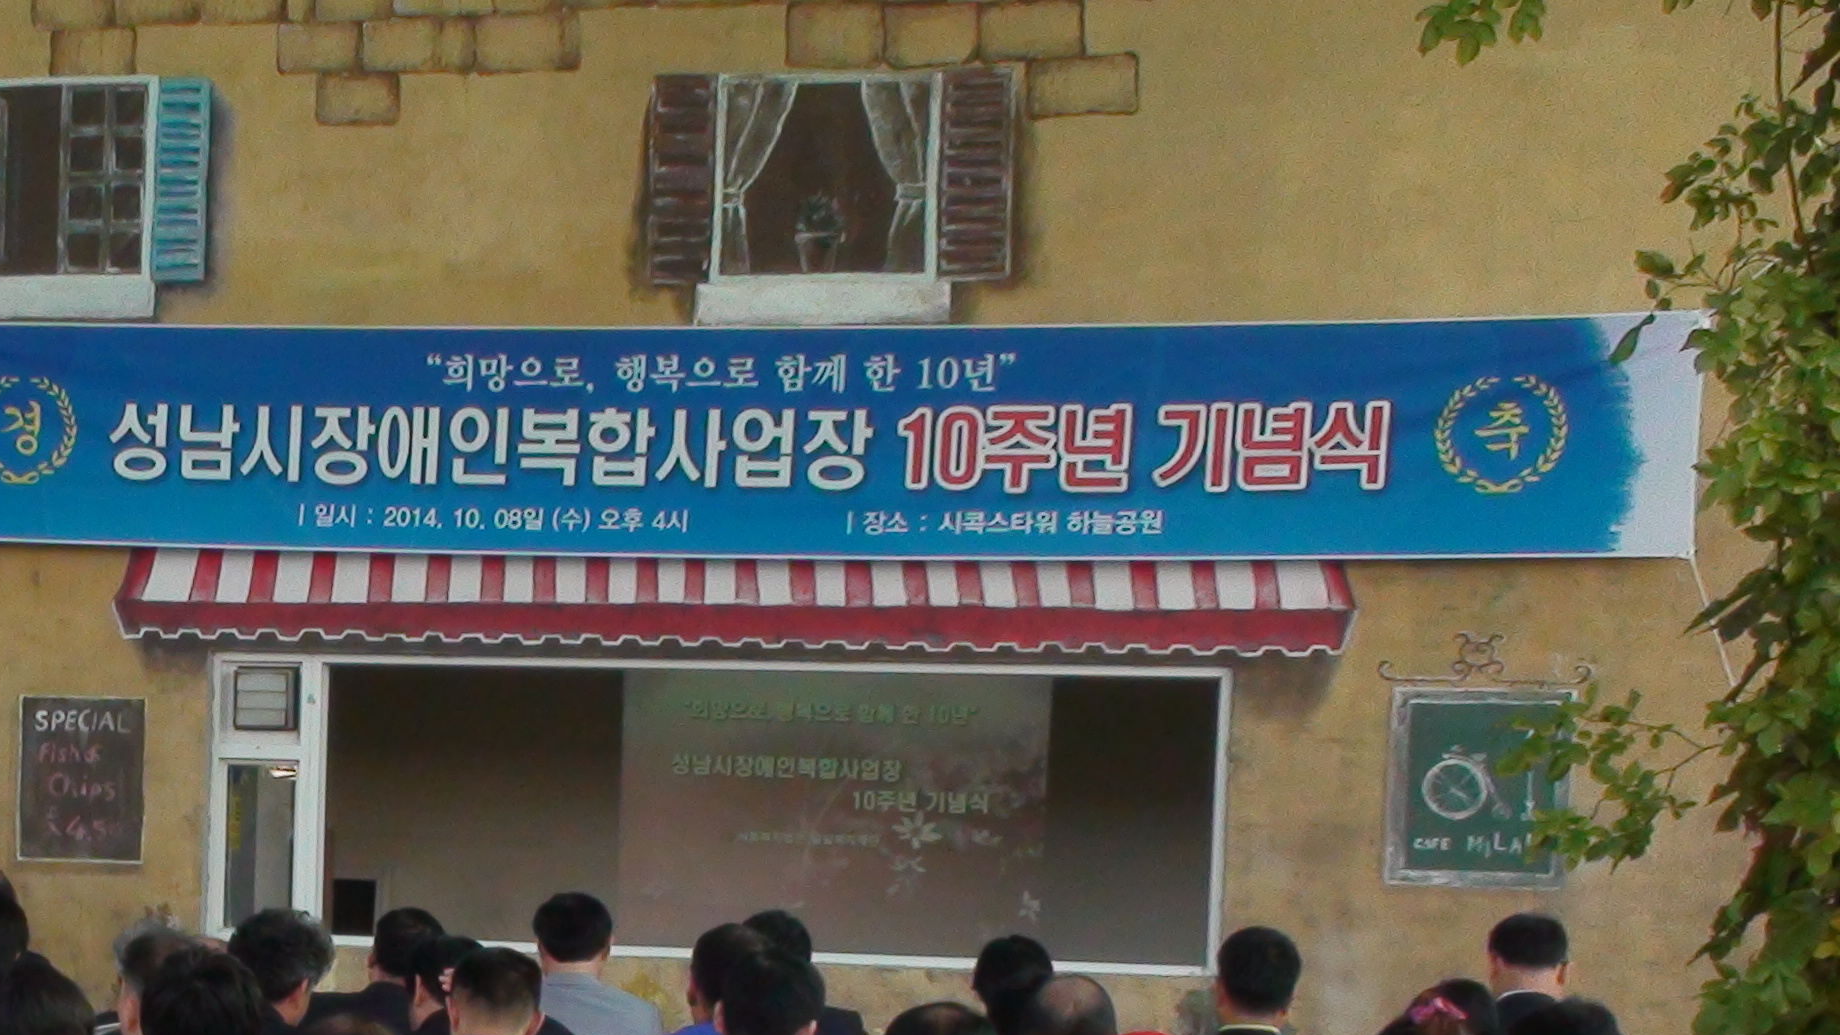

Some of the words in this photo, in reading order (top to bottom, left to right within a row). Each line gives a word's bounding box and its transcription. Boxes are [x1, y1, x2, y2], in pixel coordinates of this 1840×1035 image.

[426, 352, 594, 394] “희망으로,
[615, 353, 760, 393] 행복으로
[774, 353, 847, 394] 함께
[863, 353, 902, 393] 한
[916, 352, 1017, 393] 10년”
[0, 400, 42, 458] 경
[1474, 401, 1531, 460] 축
[108, 402, 875, 490] 성남시장애인복합사업장
[897, 402, 1135, 495] 10주년
[1152, 399, 1393, 494] 기념식
[314, 503, 357, 528] 일시
[382, 506, 444, 530] 2014.
[453, 507, 487, 531] 10.
[493, 507, 545, 531] 08일
[551, 507, 591, 533] (수)
[597, 507, 644, 533] 오후
[650, 508, 689, 534] 4시
[862, 509, 909, 536] 장소
[937, 510, 1058, 535] 시콕스타워
[1066, 509, 1164, 536] 하늘공원
[34, 708, 132, 734] SPECIAL
[671, 753, 903, 783] 성남시장애인복합사업장
[852, 789, 917, 814] 10주년
[927, 790, 989, 815] 기념식
